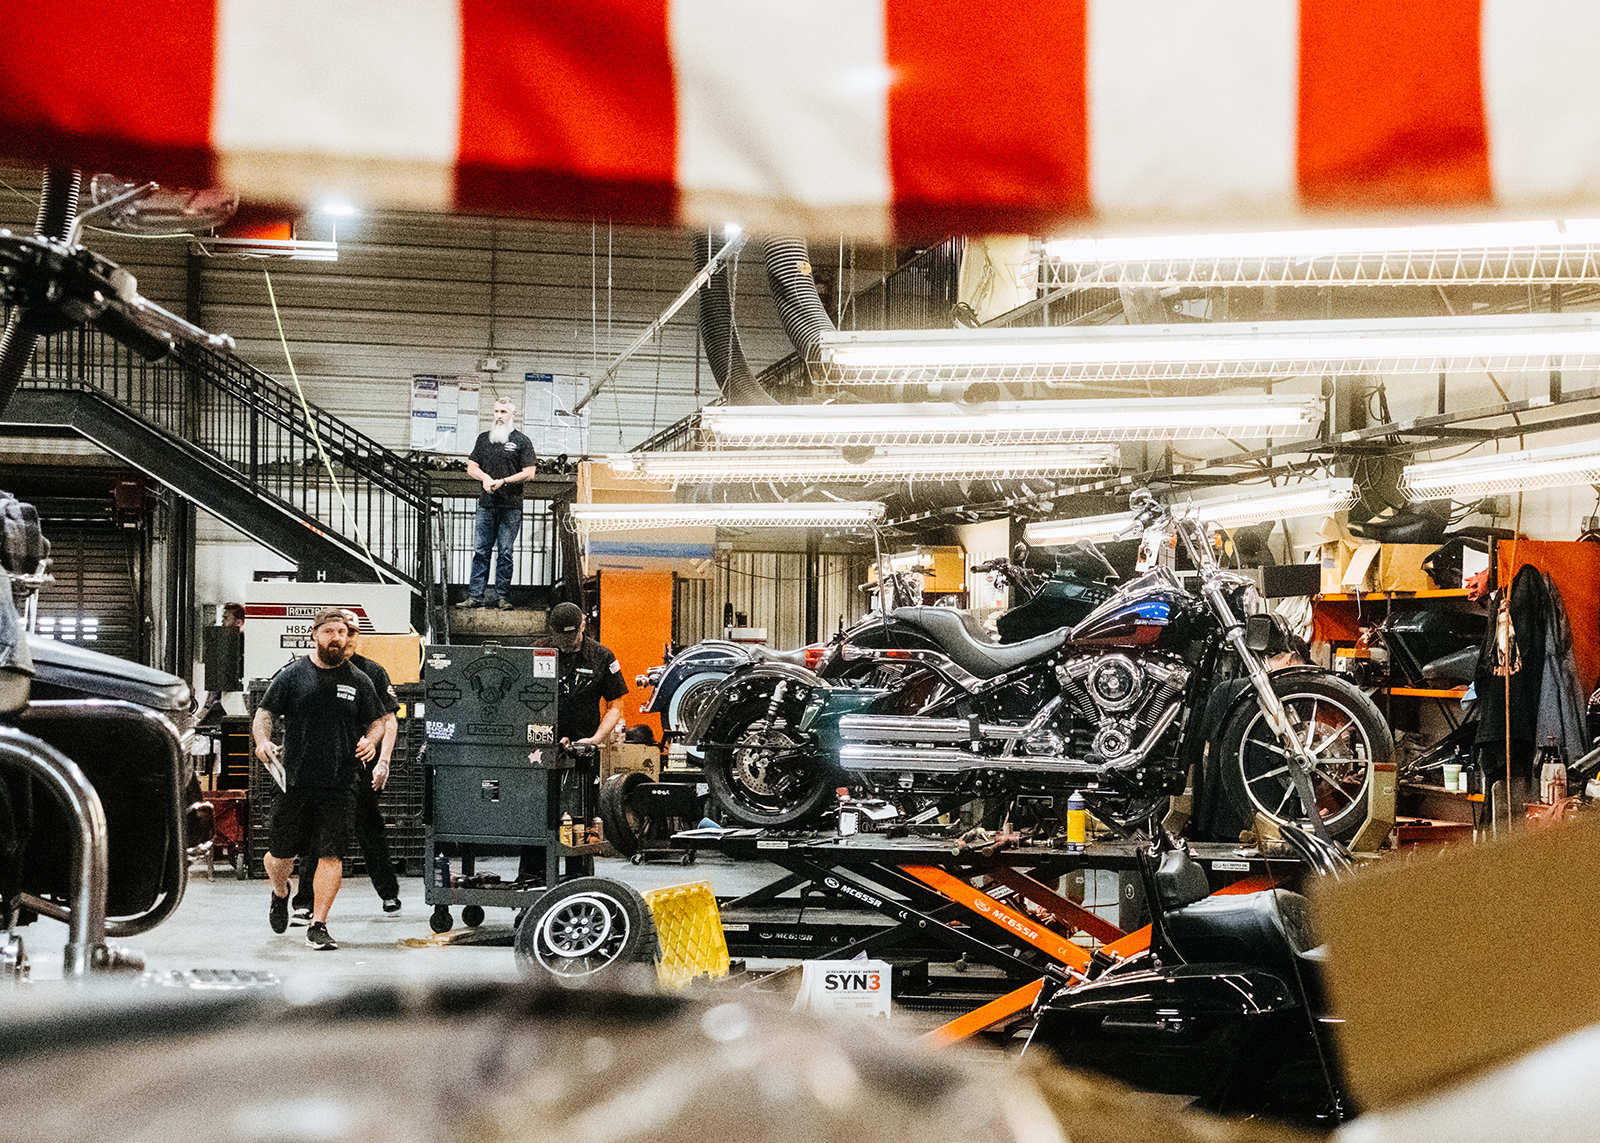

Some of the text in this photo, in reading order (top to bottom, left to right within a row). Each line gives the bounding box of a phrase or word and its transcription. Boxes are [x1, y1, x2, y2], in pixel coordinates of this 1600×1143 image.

[317, 570, 326, 581] H
[527, 732, 554, 742] BIDEN
[840, 884, 883, 908] MC655R
[991, 909, 1039, 940] MC655R
[825, 974, 881, 991] SYN3
